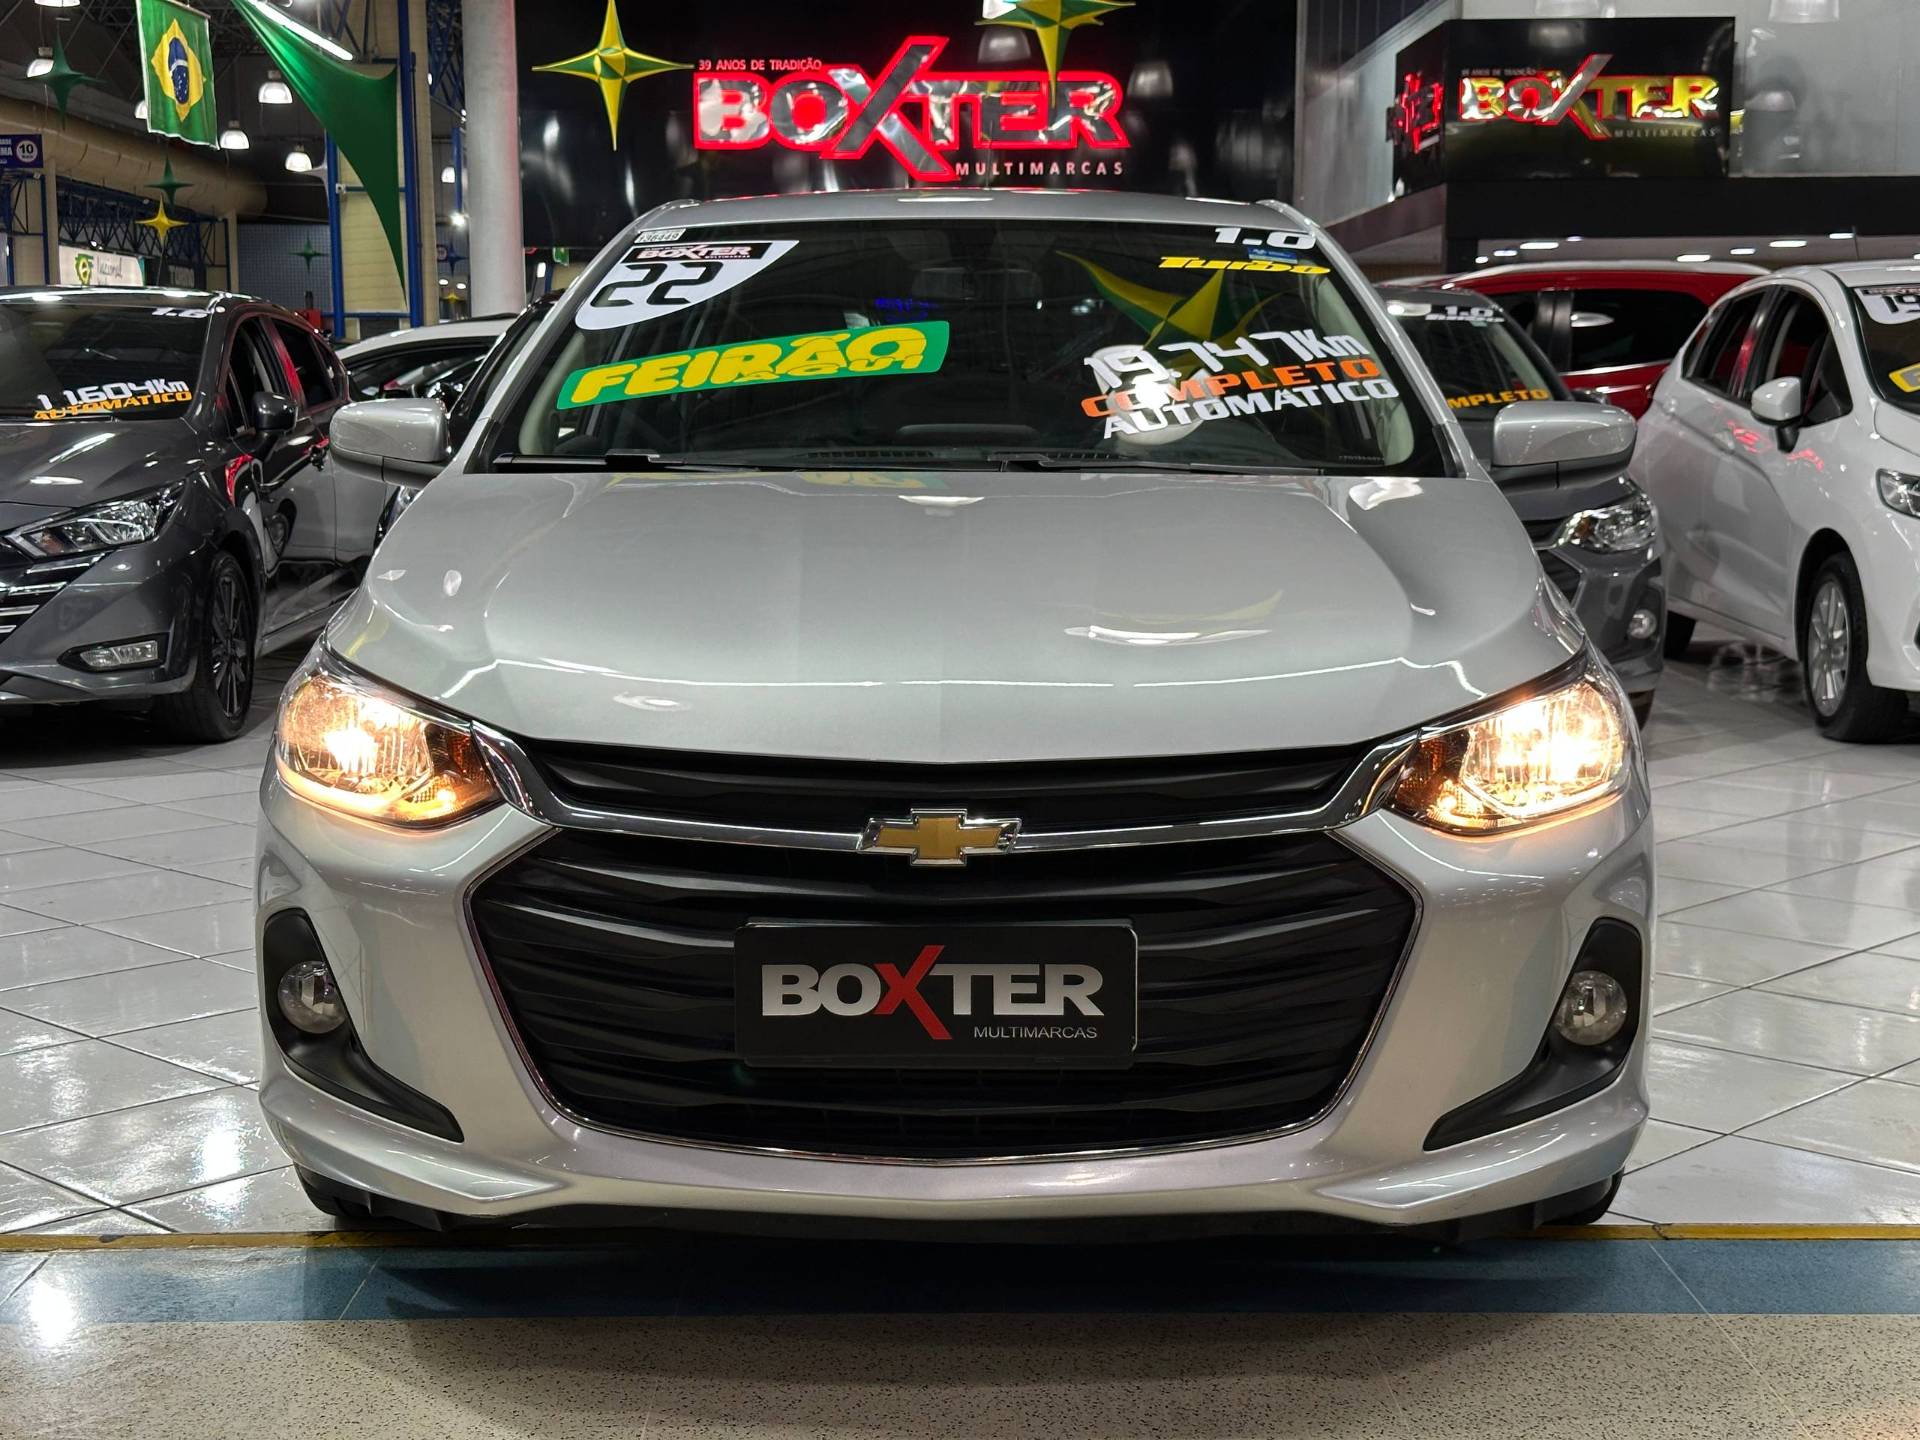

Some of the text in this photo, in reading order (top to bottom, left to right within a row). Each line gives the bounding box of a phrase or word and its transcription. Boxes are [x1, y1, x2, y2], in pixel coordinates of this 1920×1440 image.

[699, 58, 822, 72] 39 ANOS DE TRADIÇÃO
[1459, 53, 1720, 141] BOXTER
[693, 35, 1132, 182] BOXTER
[19, 143, 34, 154] 10
[955, 161, 1123, 176] MULTIMARCAS
[1214, 227, 1317, 250] 1.0
[636, 244, 752, 260] BOXTER
[1158, 256, 1331, 275] Turbo
[590, 261, 724, 307] 22
[151, 307, 208, 319] 1.6
[571, 328, 928, 403] FEIRÃO
[1080, 357, 1381, 418] COMPLETO
[1445, 389, 1550, 409] MPLETO
[761, 944, 1105, 1041] BOXTER
[973, 1026, 1098, 1039] MULTIMARCAS
